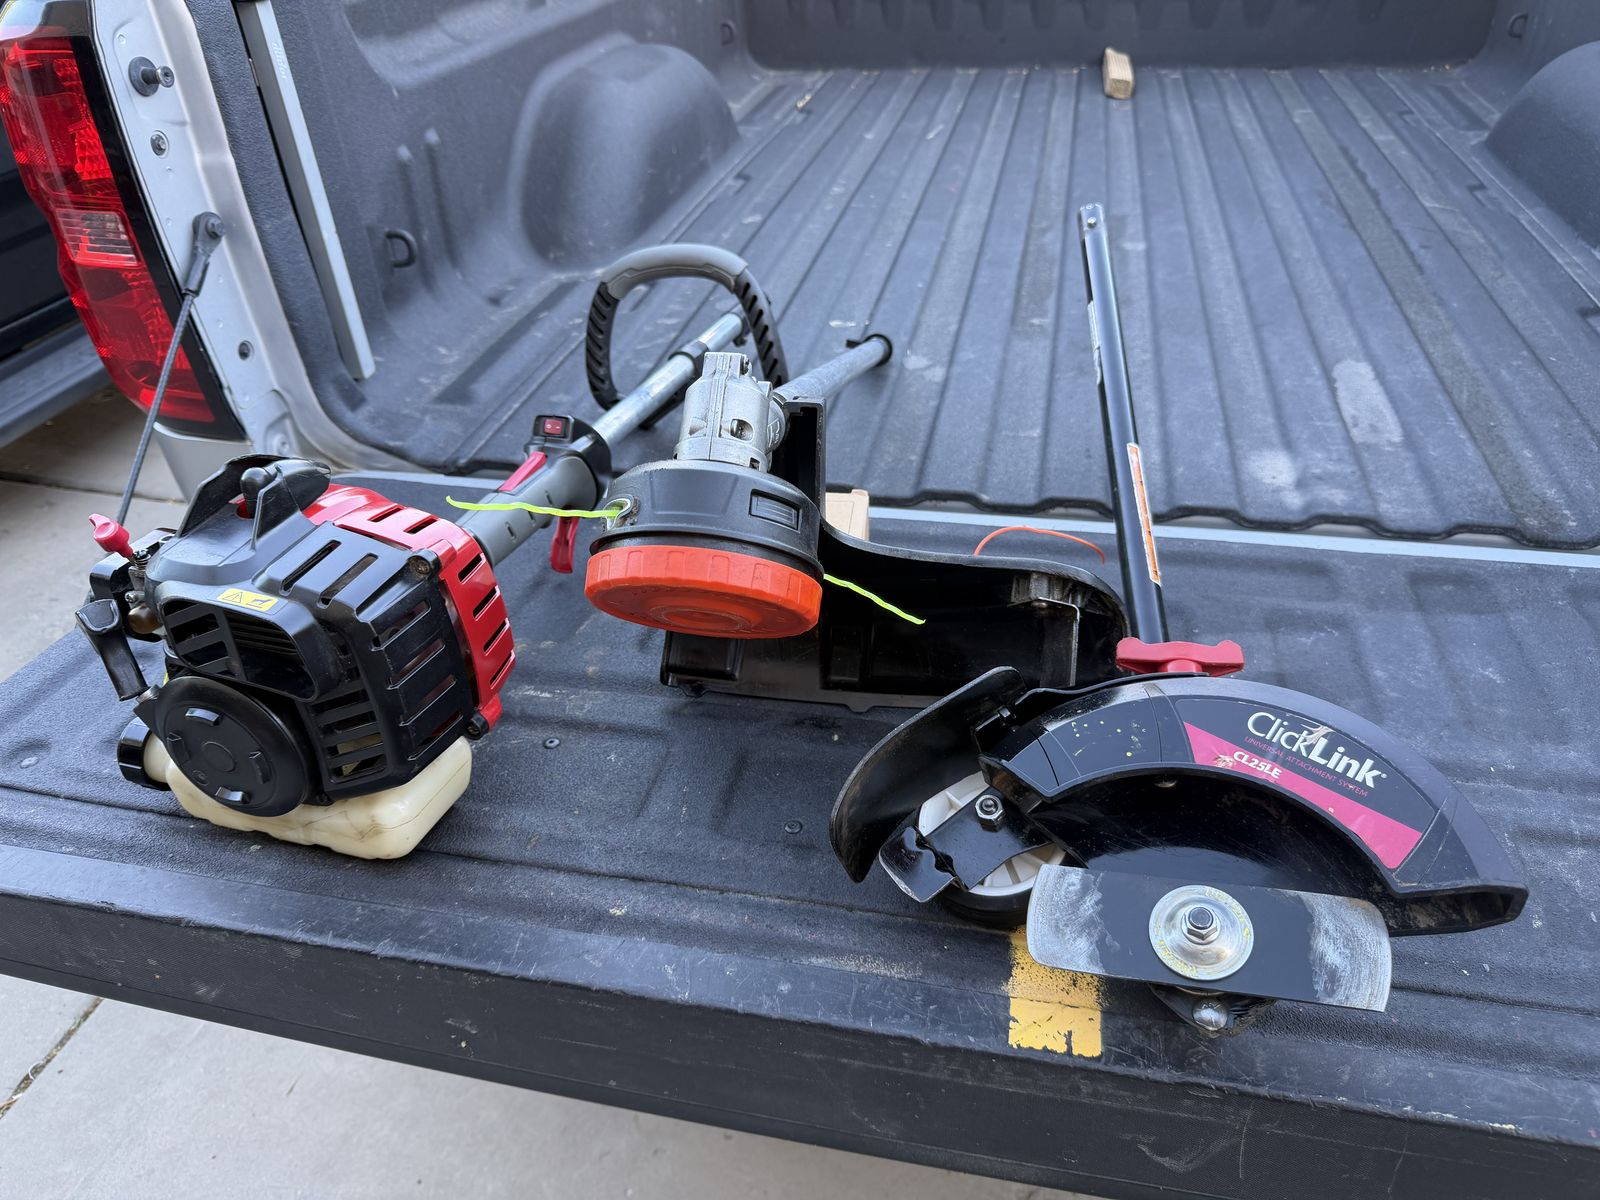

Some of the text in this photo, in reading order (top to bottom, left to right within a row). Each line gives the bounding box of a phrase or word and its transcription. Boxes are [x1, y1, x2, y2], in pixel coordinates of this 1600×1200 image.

[1233, 751, 1282, 778] CL25LE
[1244, 737, 1368, 798] UNIVERSAL ATTACHMENT SYSTEM
